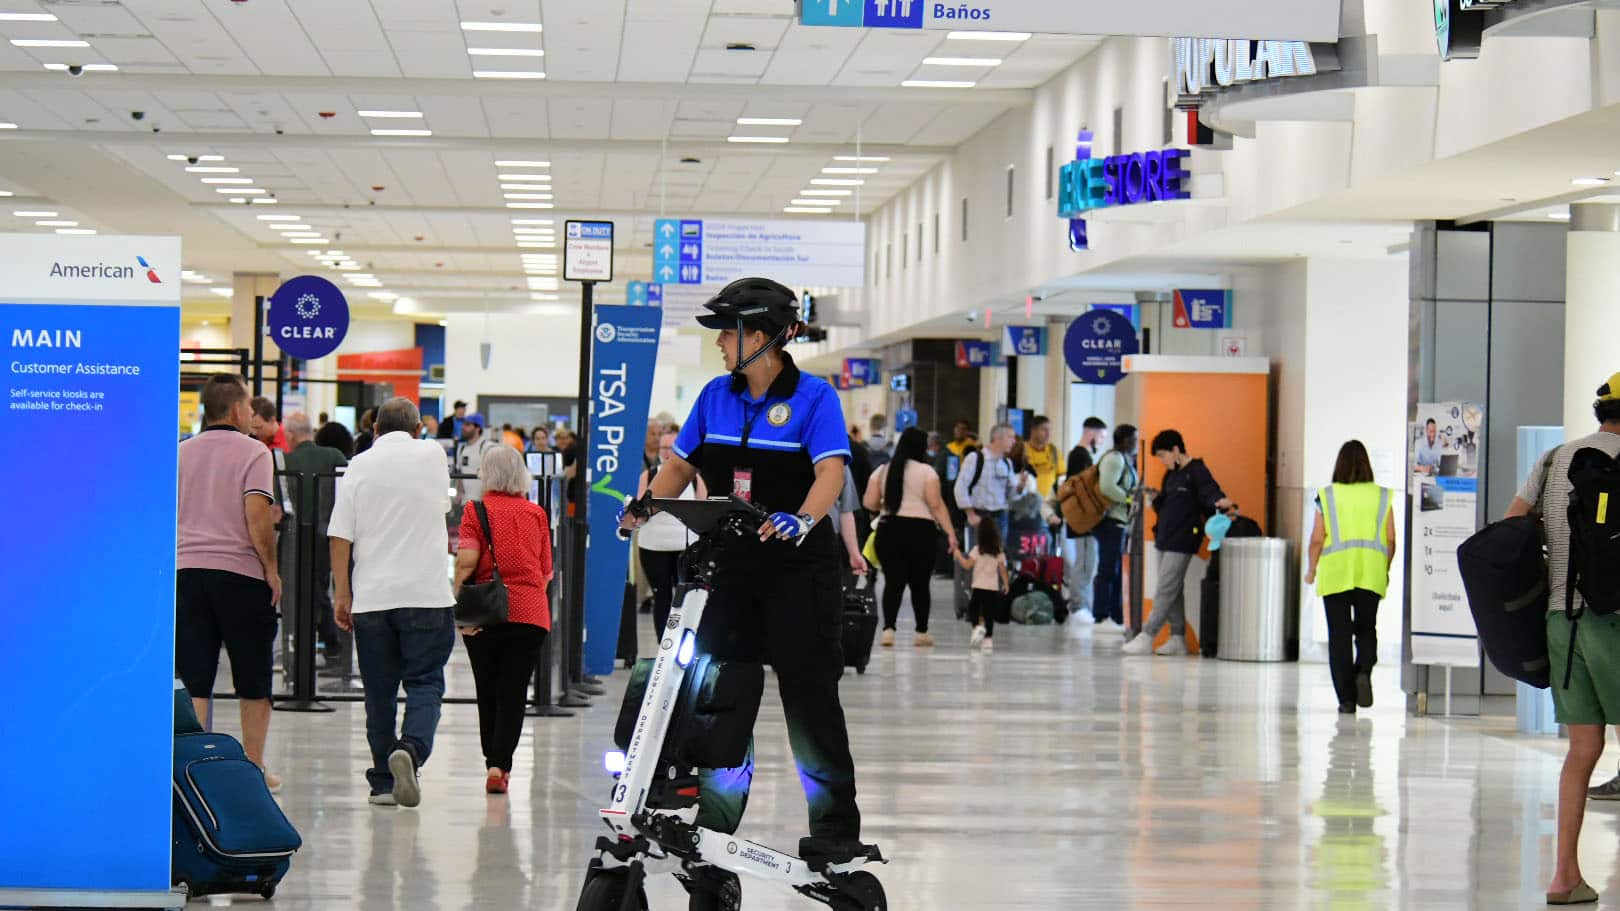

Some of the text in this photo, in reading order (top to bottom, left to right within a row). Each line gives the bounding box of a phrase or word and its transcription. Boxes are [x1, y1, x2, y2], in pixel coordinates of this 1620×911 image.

[933, 3, 991, 20] Baños
[1103, 148, 1191, 205] STORE
[50, 262, 134, 279] American
[11, 328, 82, 348] MAIN
[281, 326, 335, 339] CLEAR
[1081, 340, 1122, 349] CLEAR
[11, 361, 140, 376] Customer Assistance
[10, 388, 105, 400] Self-service kiosks are
[10, 400, 103, 411] available for check-in
[597, 362, 627, 473] TSA Pre
[616, 784, 627, 803] 3
[740, 851, 780, 869] DEPARTMENT
[747, 847, 775, 860] SECURITY
[786, 861, 792, 874] 3
